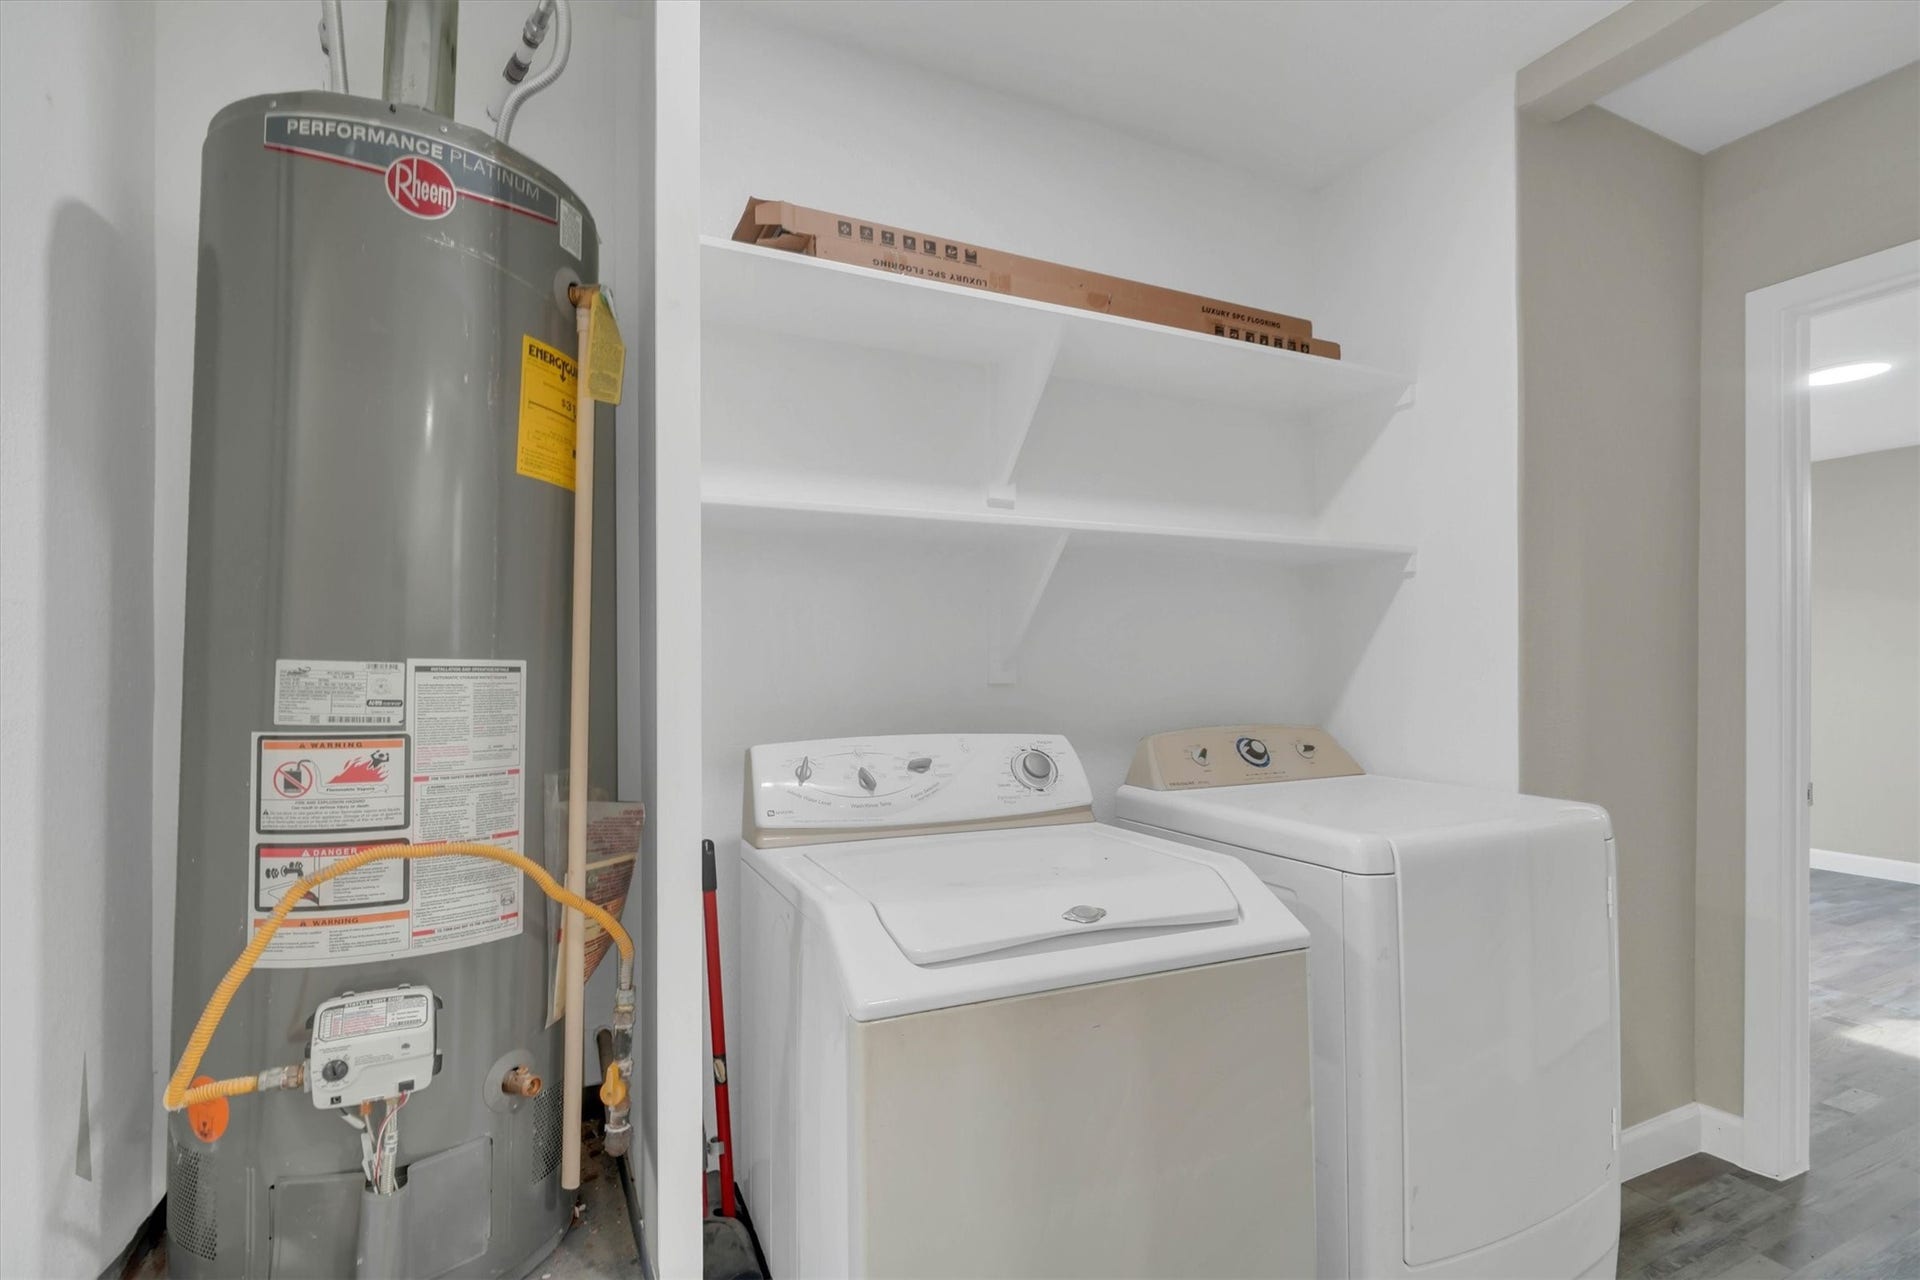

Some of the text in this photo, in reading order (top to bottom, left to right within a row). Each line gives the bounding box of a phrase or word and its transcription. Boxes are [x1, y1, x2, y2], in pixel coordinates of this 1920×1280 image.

[287, 118, 541, 201] PERFORMANCE PLATINUM
[394, 157, 452, 208] Rheem
[872, 258, 924, 274] FLOORING
[928, 269, 946, 279] SPC
[949, 274, 988, 287] LUXURY
[1201, 305, 1281, 329] LUXURY SPC FLOORING
[310, 741, 363, 749] WARNING
[313, 847, 358, 857] DANGER
[312, 917, 359, 927] WARNING
